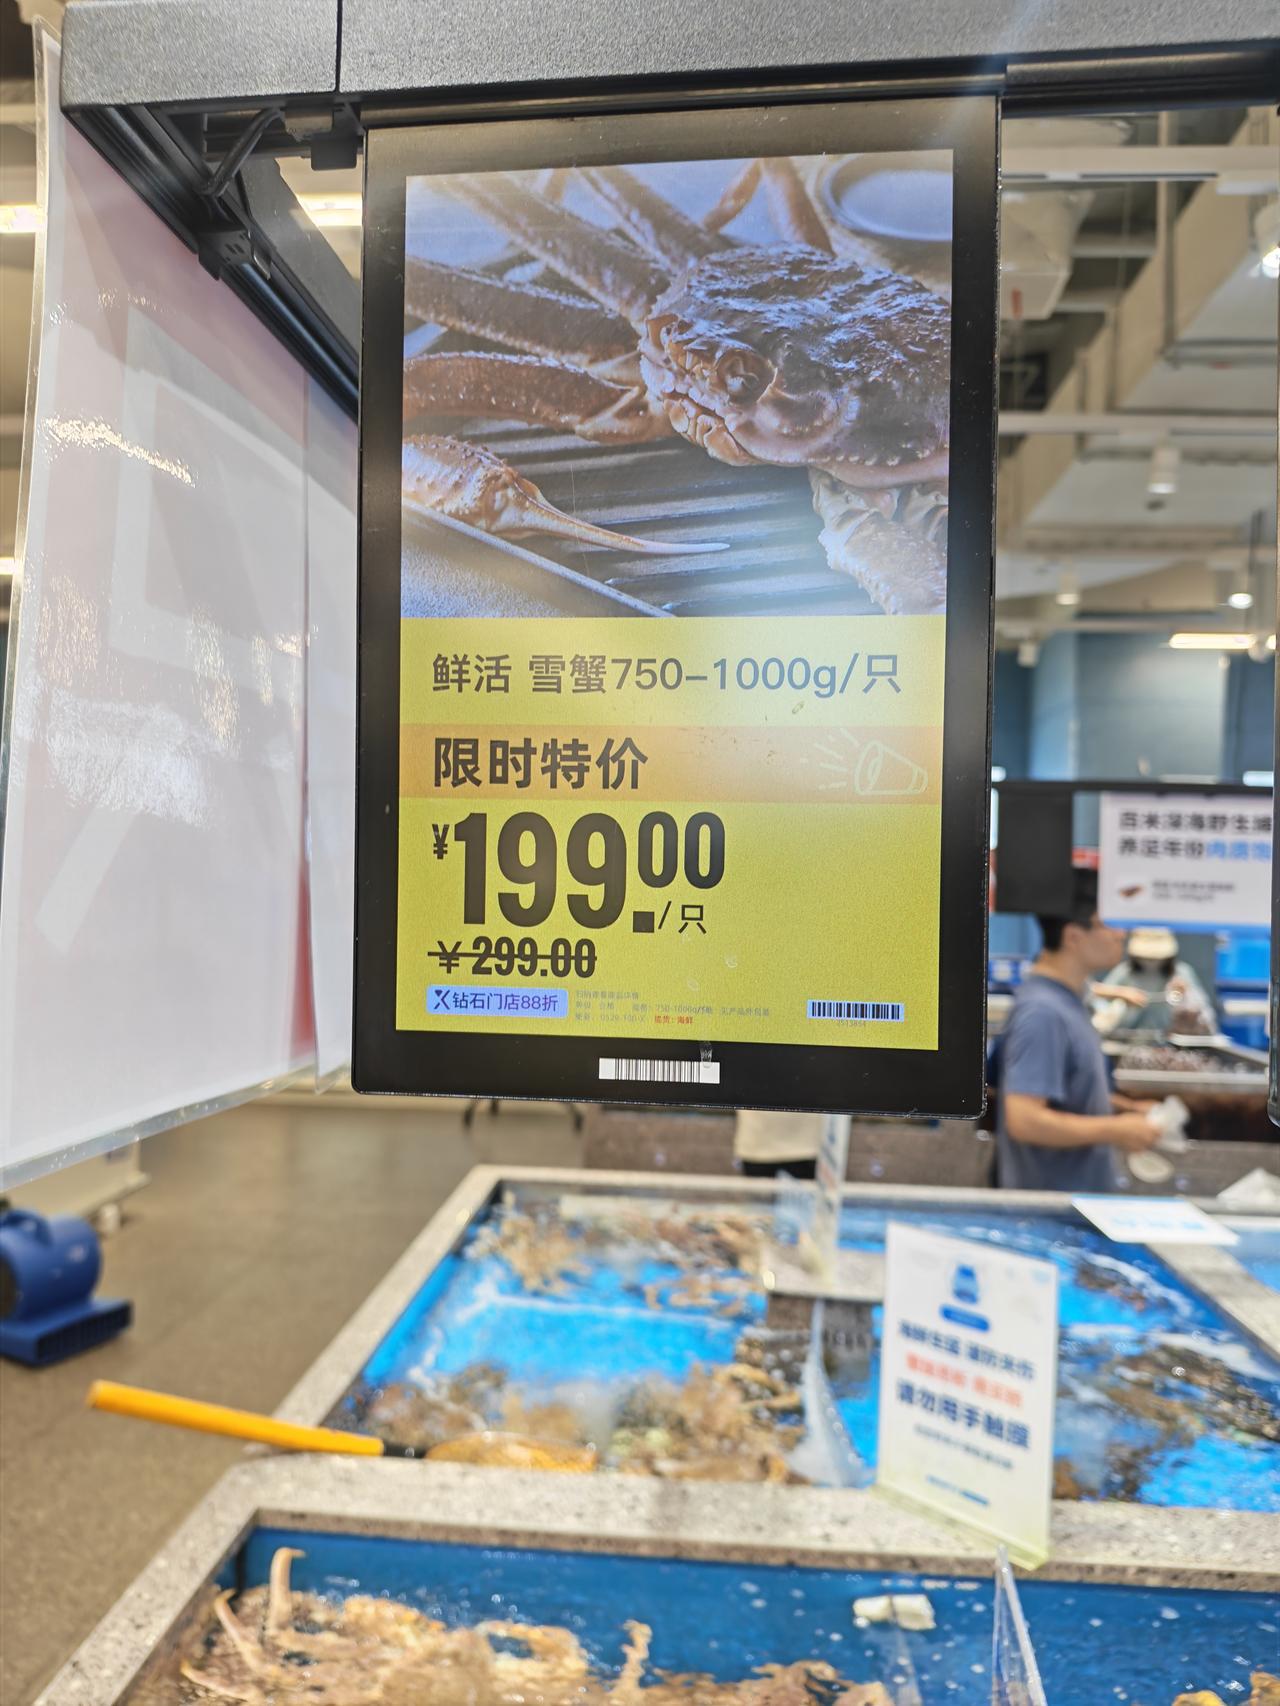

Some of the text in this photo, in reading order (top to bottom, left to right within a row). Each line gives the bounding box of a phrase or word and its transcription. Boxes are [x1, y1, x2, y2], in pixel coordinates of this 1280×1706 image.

[432, 653, 512, 694] 鲜活
[433, 737, 649, 790] 限时特价
